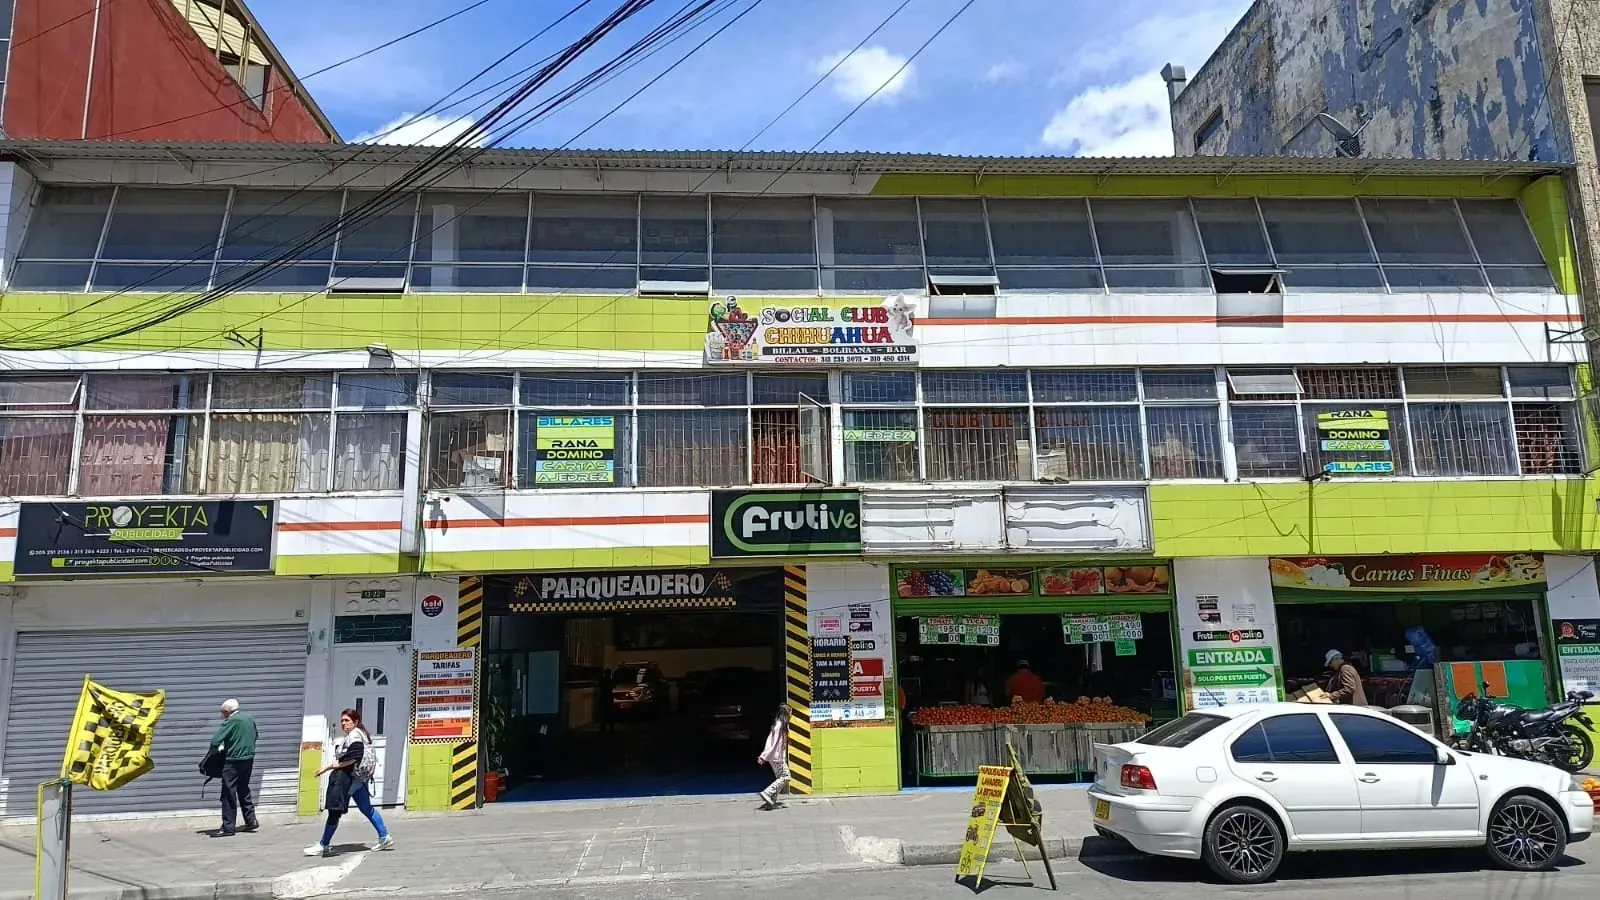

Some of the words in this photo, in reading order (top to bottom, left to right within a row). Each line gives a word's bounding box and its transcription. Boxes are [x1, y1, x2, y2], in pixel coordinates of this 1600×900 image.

[762, 307, 834, 325] SOCIAL
[841, 307, 889, 323] CLUB
[764, 327, 894, 344] CHIHUAHUA
[539, 416, 612, 425] BILLARES
[844, 430, 916, 441] AJEDREZ
[1329, 430, 1380, 439] DOMINO
[552, 440, 598, 448] RANA
[1327, 441, 1385, 449] CARTAS
[546, 450, 604, 459] DOMINO
[542, 461, 607, 471] CARTAS
[1324, 462, 1392, 471] BILLARES
[537, 472, 609, 482] AJEDREZ
[84, 506, 208, 527] PROYEKTA
[115, 530, 176, 538] PUBLICIDAD
[1350, 564, 1415, 581] Carnes
[1421, 564, 1470, 580] Finas
[542, 573, 705, 600] PARQUEADERO
[814, 638, 846, 647] HORARIO
[421, 651, 472, 660] PARQUEADERO
[1195, 650, 1266, 664] ENTRADA
[432, 661, 461, 669] TARIFAS
